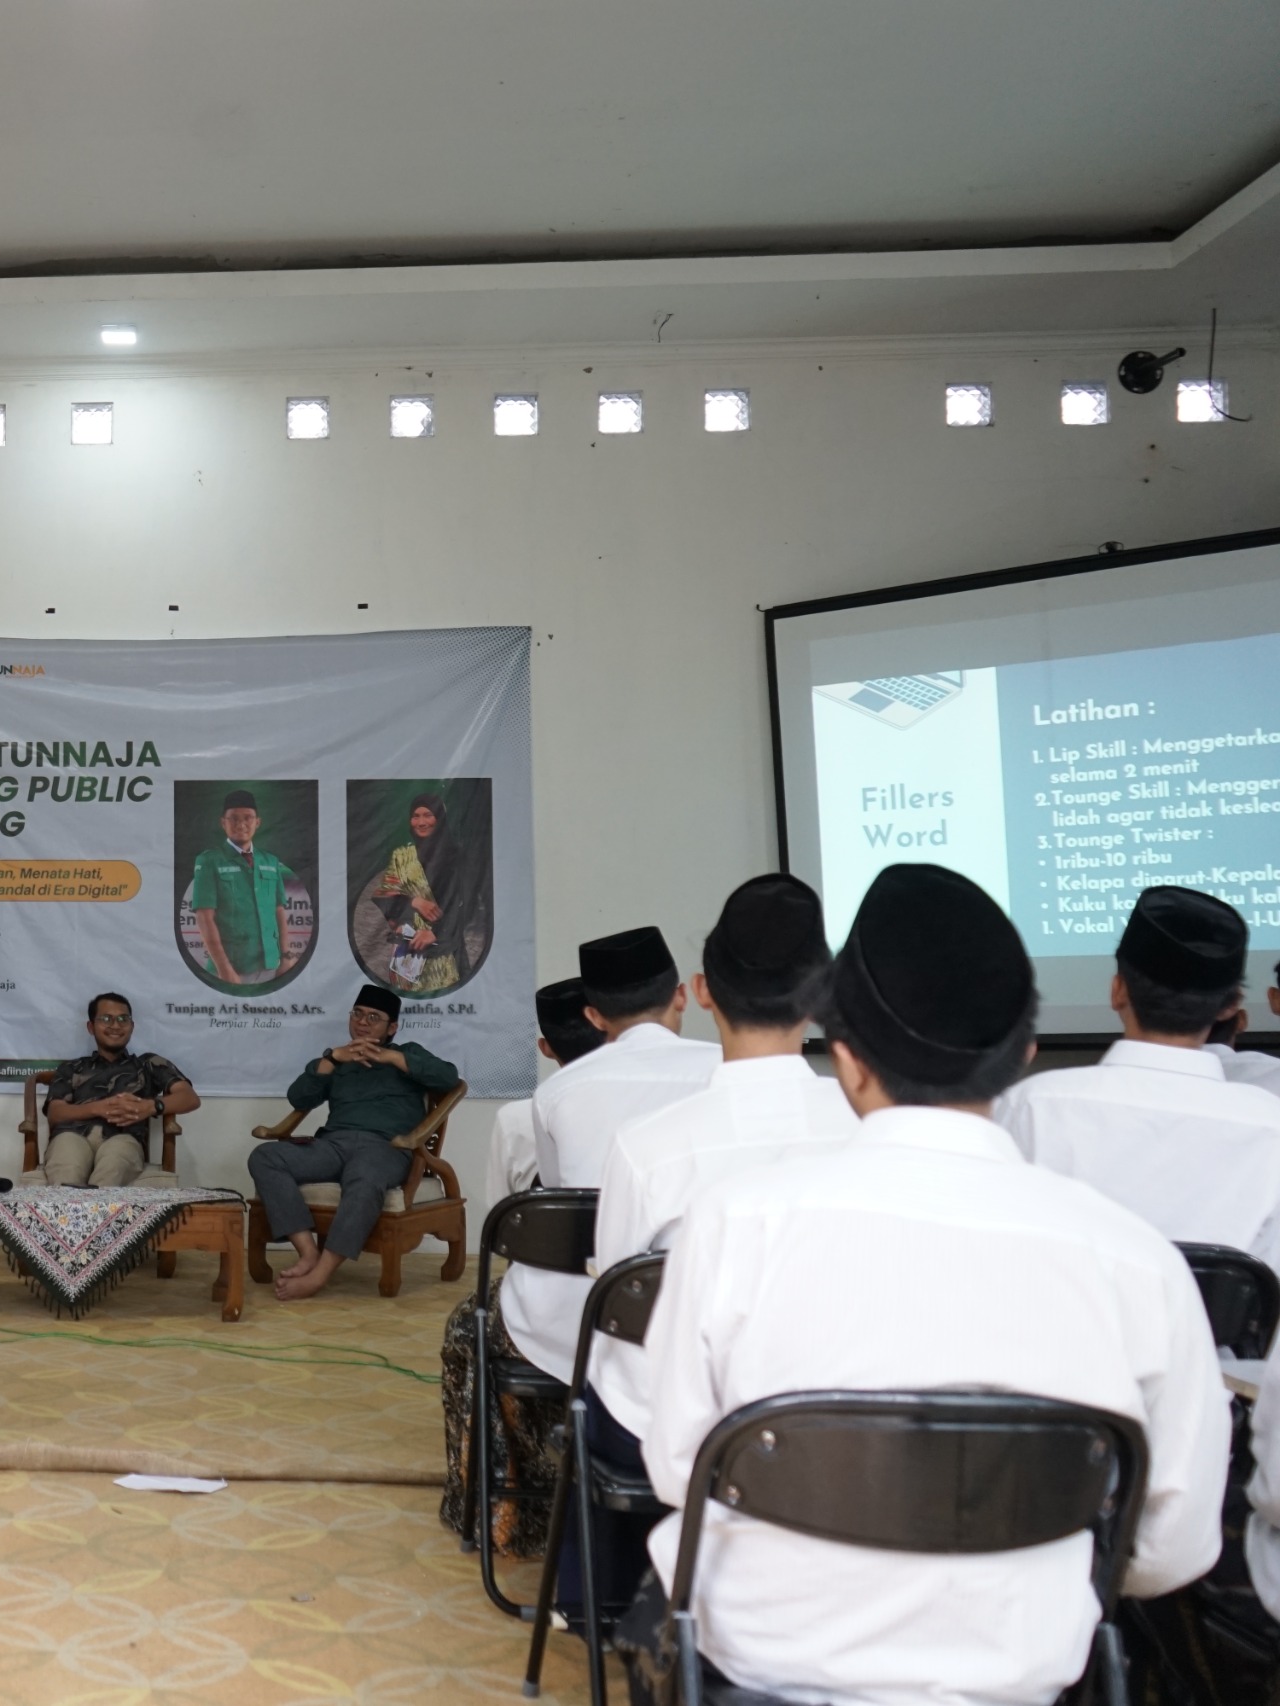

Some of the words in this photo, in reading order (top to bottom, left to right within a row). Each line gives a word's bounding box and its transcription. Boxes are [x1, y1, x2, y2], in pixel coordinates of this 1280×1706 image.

[1032, 698, 1139, 726] Latihan
[1049, 747, 1080, 765] Lip
[1085, 739, 1127, 760] Skill
[1050, 766, 1118, 784] selama
[1123, 763, 1138, 779] 2
[1143, 758, 1200, 777] menit
[27, 775, 154, 802] PUBLIC
[862, 783, 954, 812] Fillers
[1128, 780, 1169, 800] Skill
[1052, 808, 1101, 827] lidah
[1106, 810, 1154, 827] agar
[1160, 800, 1213, 819] tidak
[862, 818, 949, 849] Word
[1130, 827, 1202, 844] Twister
[1132, 847, 1173, 866] ribu
[20, 867, 71, 879] Menata
[73, 867, 103, 881] Hati,
[1056, 873, 1125, 894] Kelapa
[38, 883, 52, 896] di
[54, 884, 75, 896] Era
[1058, 895, 1107, 913] Kuku
[1059, 916, 1115, 934] Vokal
[165, 1003, 215, 1017] Tunjang
[219, 1003, 238, 1014] Ari
[242, 1003, 287, 1016] Suseno,
[291, 1003, 326, 1015] S.Ars.
[447, 1003, 477, 1015] S.Pd.
[209, 1018, 249, 1031] Penyiar
[252, 1018, 282, 1029] Radio
[400, 1018, 441, 1031] Jurnalis
